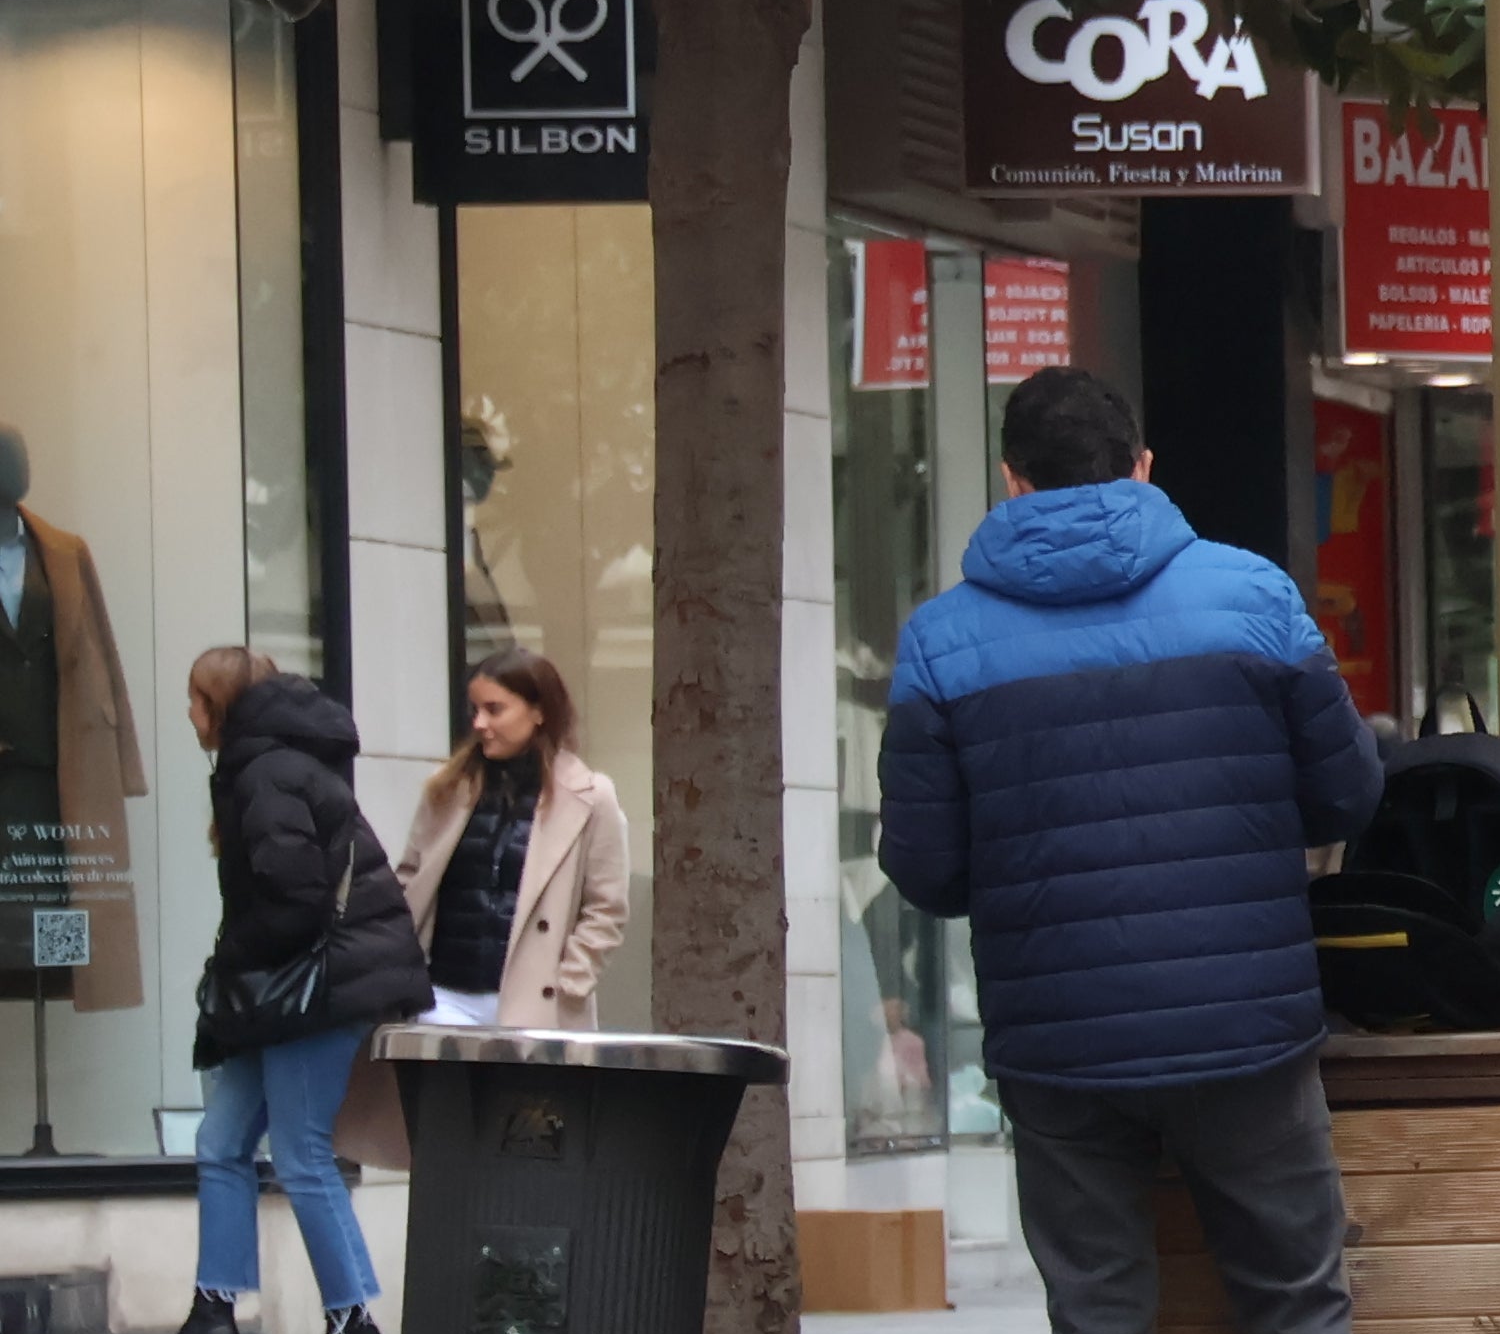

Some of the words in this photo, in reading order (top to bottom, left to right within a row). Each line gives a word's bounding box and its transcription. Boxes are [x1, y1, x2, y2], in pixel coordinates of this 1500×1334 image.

[465, 124, 636, 154] SILBON
[1072, 113, 1202, 152] Susan
[1353, 118, 1488, 190] BAZA
[1108, 163, 1171, 184] Fiesta
[1176, 167, 1190, 187] y
[1196, 163, 1283, 184] Madrina
[32, 824, 111, 842] WOMAN
